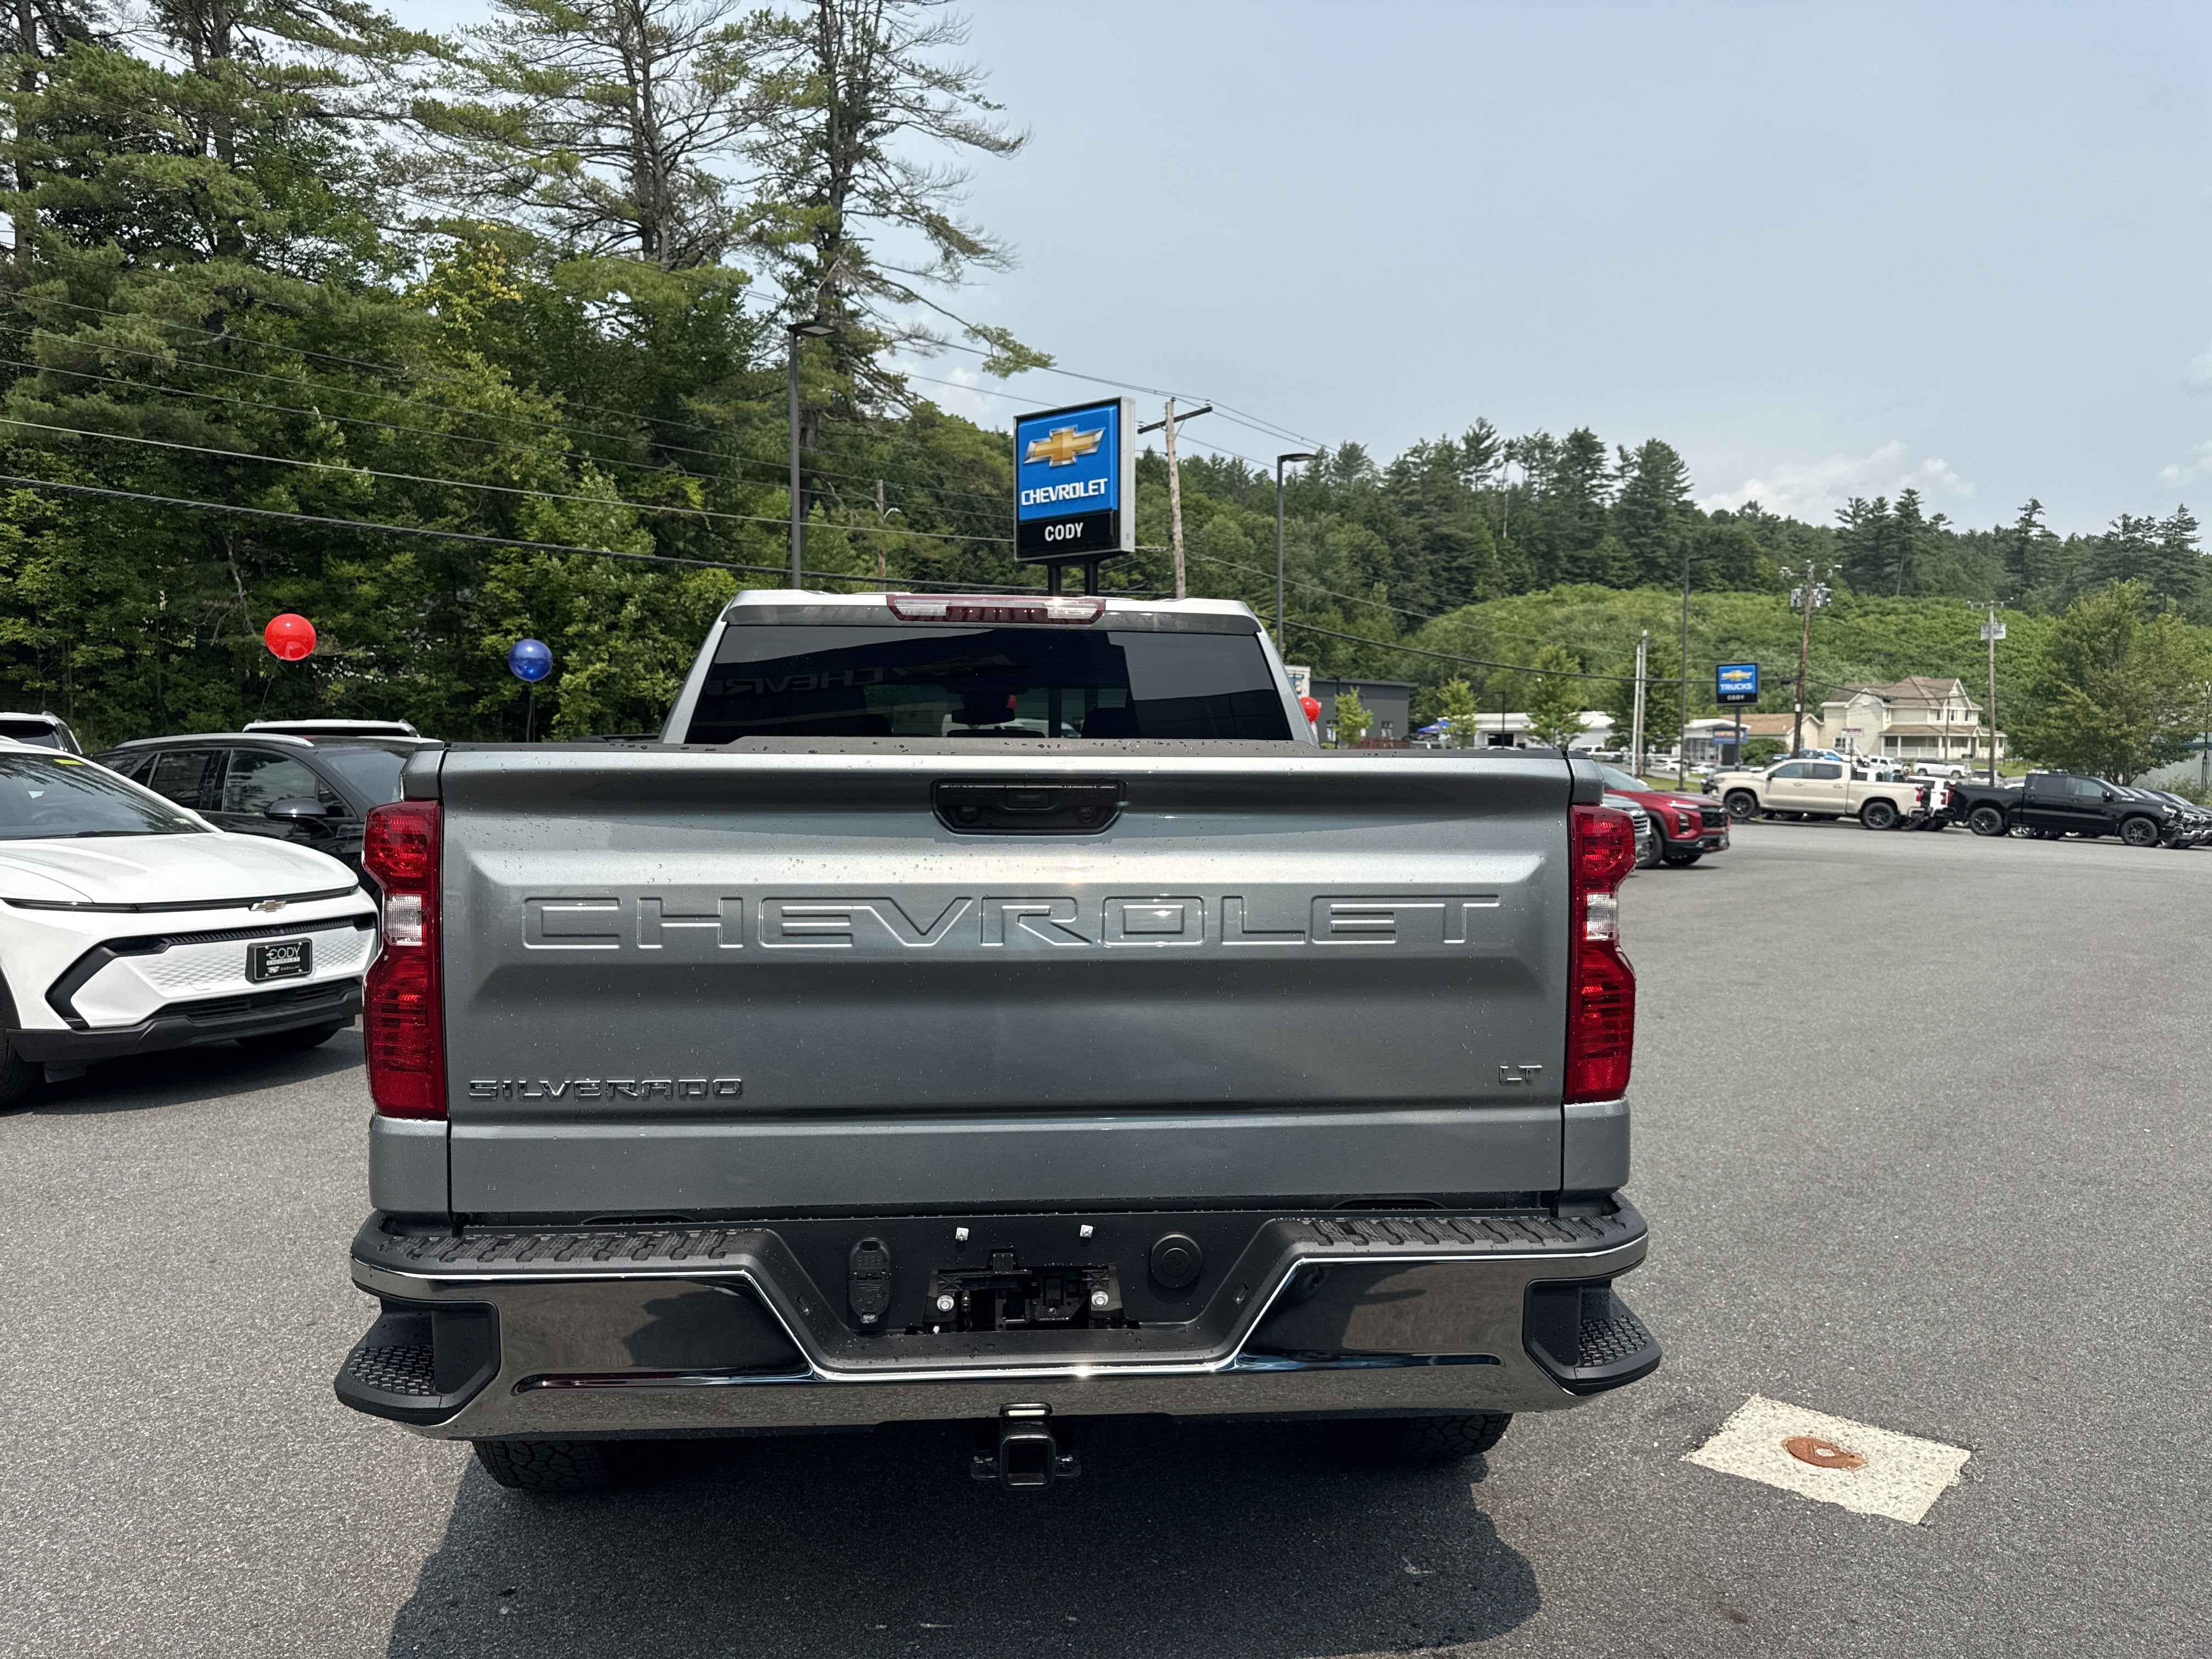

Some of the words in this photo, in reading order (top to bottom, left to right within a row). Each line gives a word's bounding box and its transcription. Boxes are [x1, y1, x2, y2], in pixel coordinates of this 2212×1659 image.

[1021, 478, 1108, 506] CHEVROLET
[1045, 522, 1084, 541] CODY
[522, 894, 1500, 949] CHEVROLET
[268, 946, 301, 960] CODY
[1499, 1064, 1543, 1084] LT
[469, 1077, 743, 1099] SILVERADO
